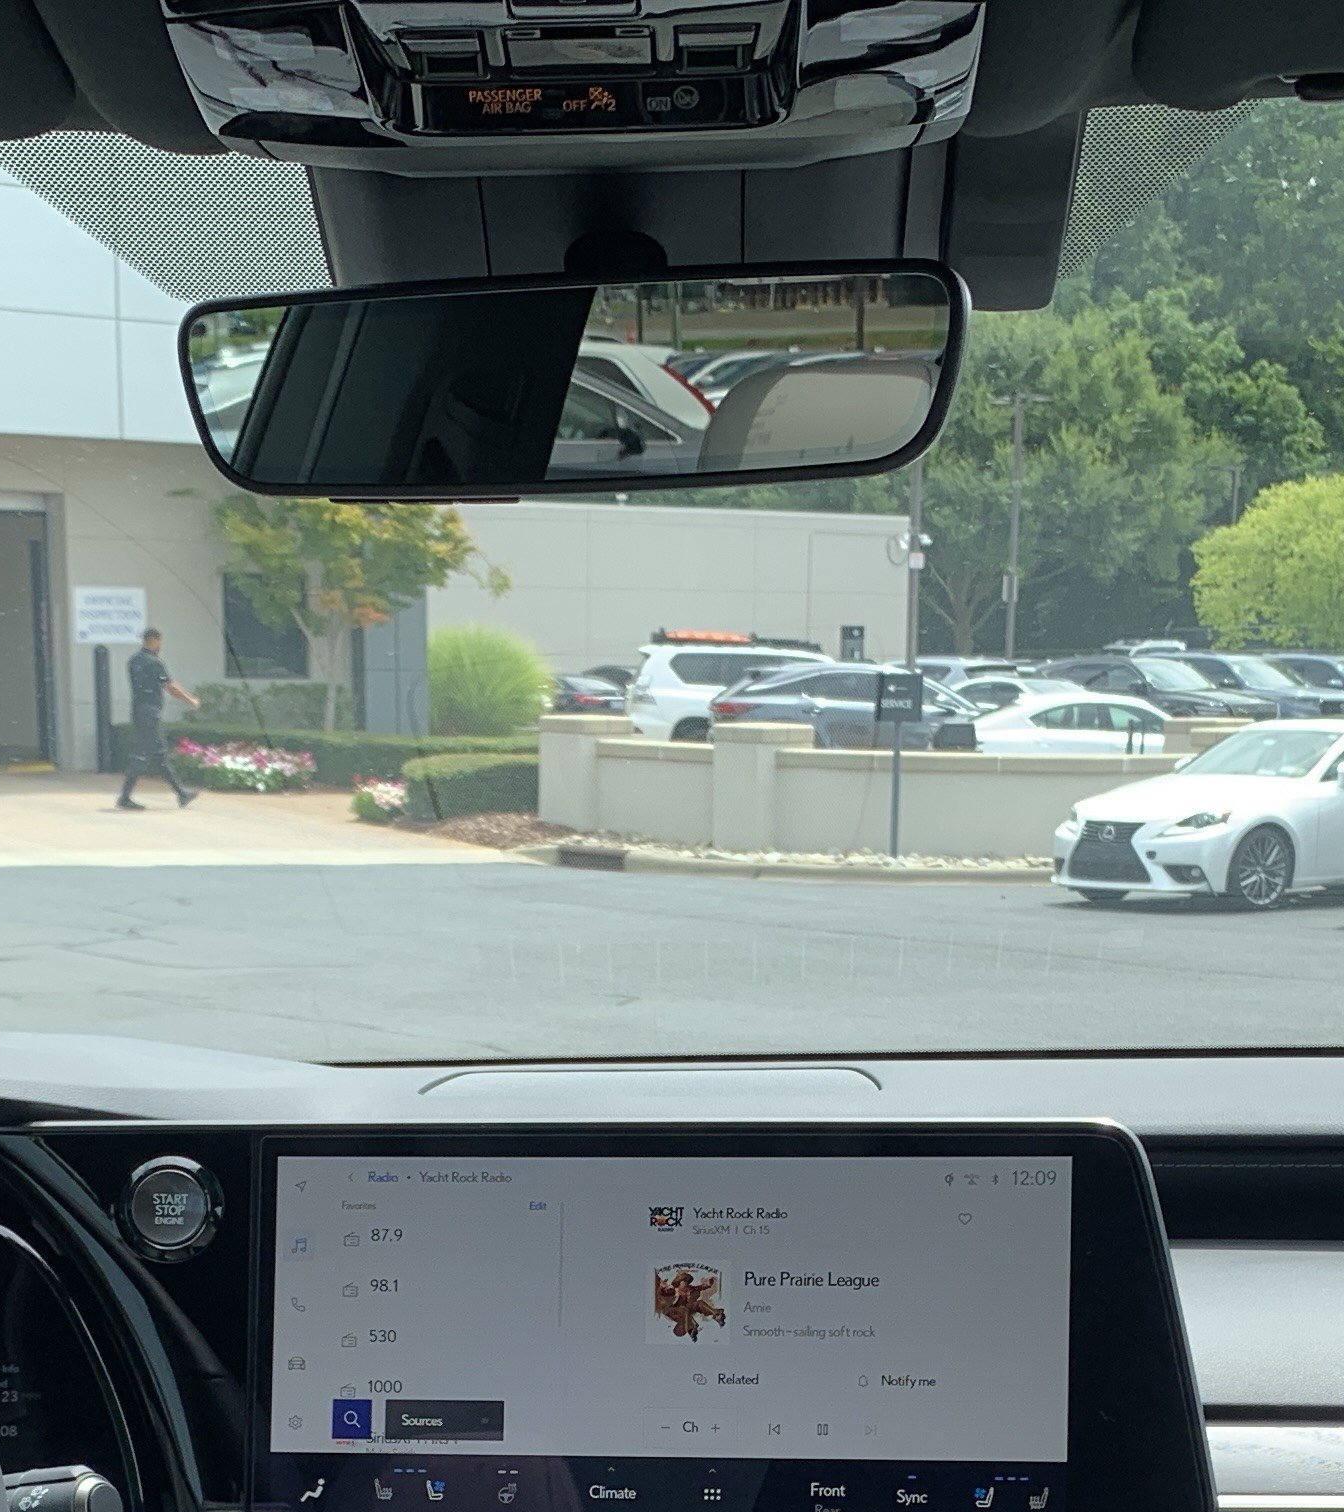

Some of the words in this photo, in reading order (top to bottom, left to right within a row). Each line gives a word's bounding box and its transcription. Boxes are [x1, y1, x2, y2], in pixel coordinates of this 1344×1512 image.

[469, 88, 542, 103] PASSENGER
[482, 101, 503, 114] AIR
[505, 101, 532, 114] BAG
[563, 100, 586, 113] OFF
[368, 1171, 399, 1183] Radio
[419, 1171, 449, 1183] Yacht
[451, 1171, 478, 1183] Rock
[481, 1171, 512, 1183] Radio
[1012, 1170, 1056, 1186] 12:09
[152, 1193, 189, 1205] START
[341, 1200, 377, 1211] Favorites
[529, 1200, 547, 1211] Edit
[155, 1204, 186, 1216] STOP
[648, 1206, 684, 1217] YACHT
[693, 1208, 724, 1219] Yacht
[726, 1208, 754, 1219] Rock
[756, 1208, 788, 1219] Radio
[154, 1216, 185, 1225] ENGINE
[649, 1216, 683, 1227] ROCK
[370, 1228, 404, 1243] 87.9
[692, 1225, 731, 1235] SiriusXM
[742, 1225, 757, 1235] Ch
[758, 1225, 770, 1235] 15
[370, 1279, 399, 1293] 98.1
[744, 1272, 776, 1287] Pure
[780, 1272, 824, 1287] Prairie
[827, 1272, 880, 1290] League
[369, 1329, 397, 1343] 530
[743, 1325, 826, 1339] Smooth-sailing
[828, 1325, 850, 1338] soft
[852, 1325, 876, 1338] rock
[367, 1379, 403, 1394] 1000
[717, 1373, 759, 1385] Related
[881, 1375, 917, 1388] Notify
[918, 1378, 936, 1387] me
[1, 1390, 19, 1403] 23
[401, 1413, 444, 1427] Sources
[682, 1421, 699, 1433] Ch
[589, 1484, 637, 1500] Climate
[810, 1482, 846, 1497] Front
[896, 1488, 928, 1505] Sync
